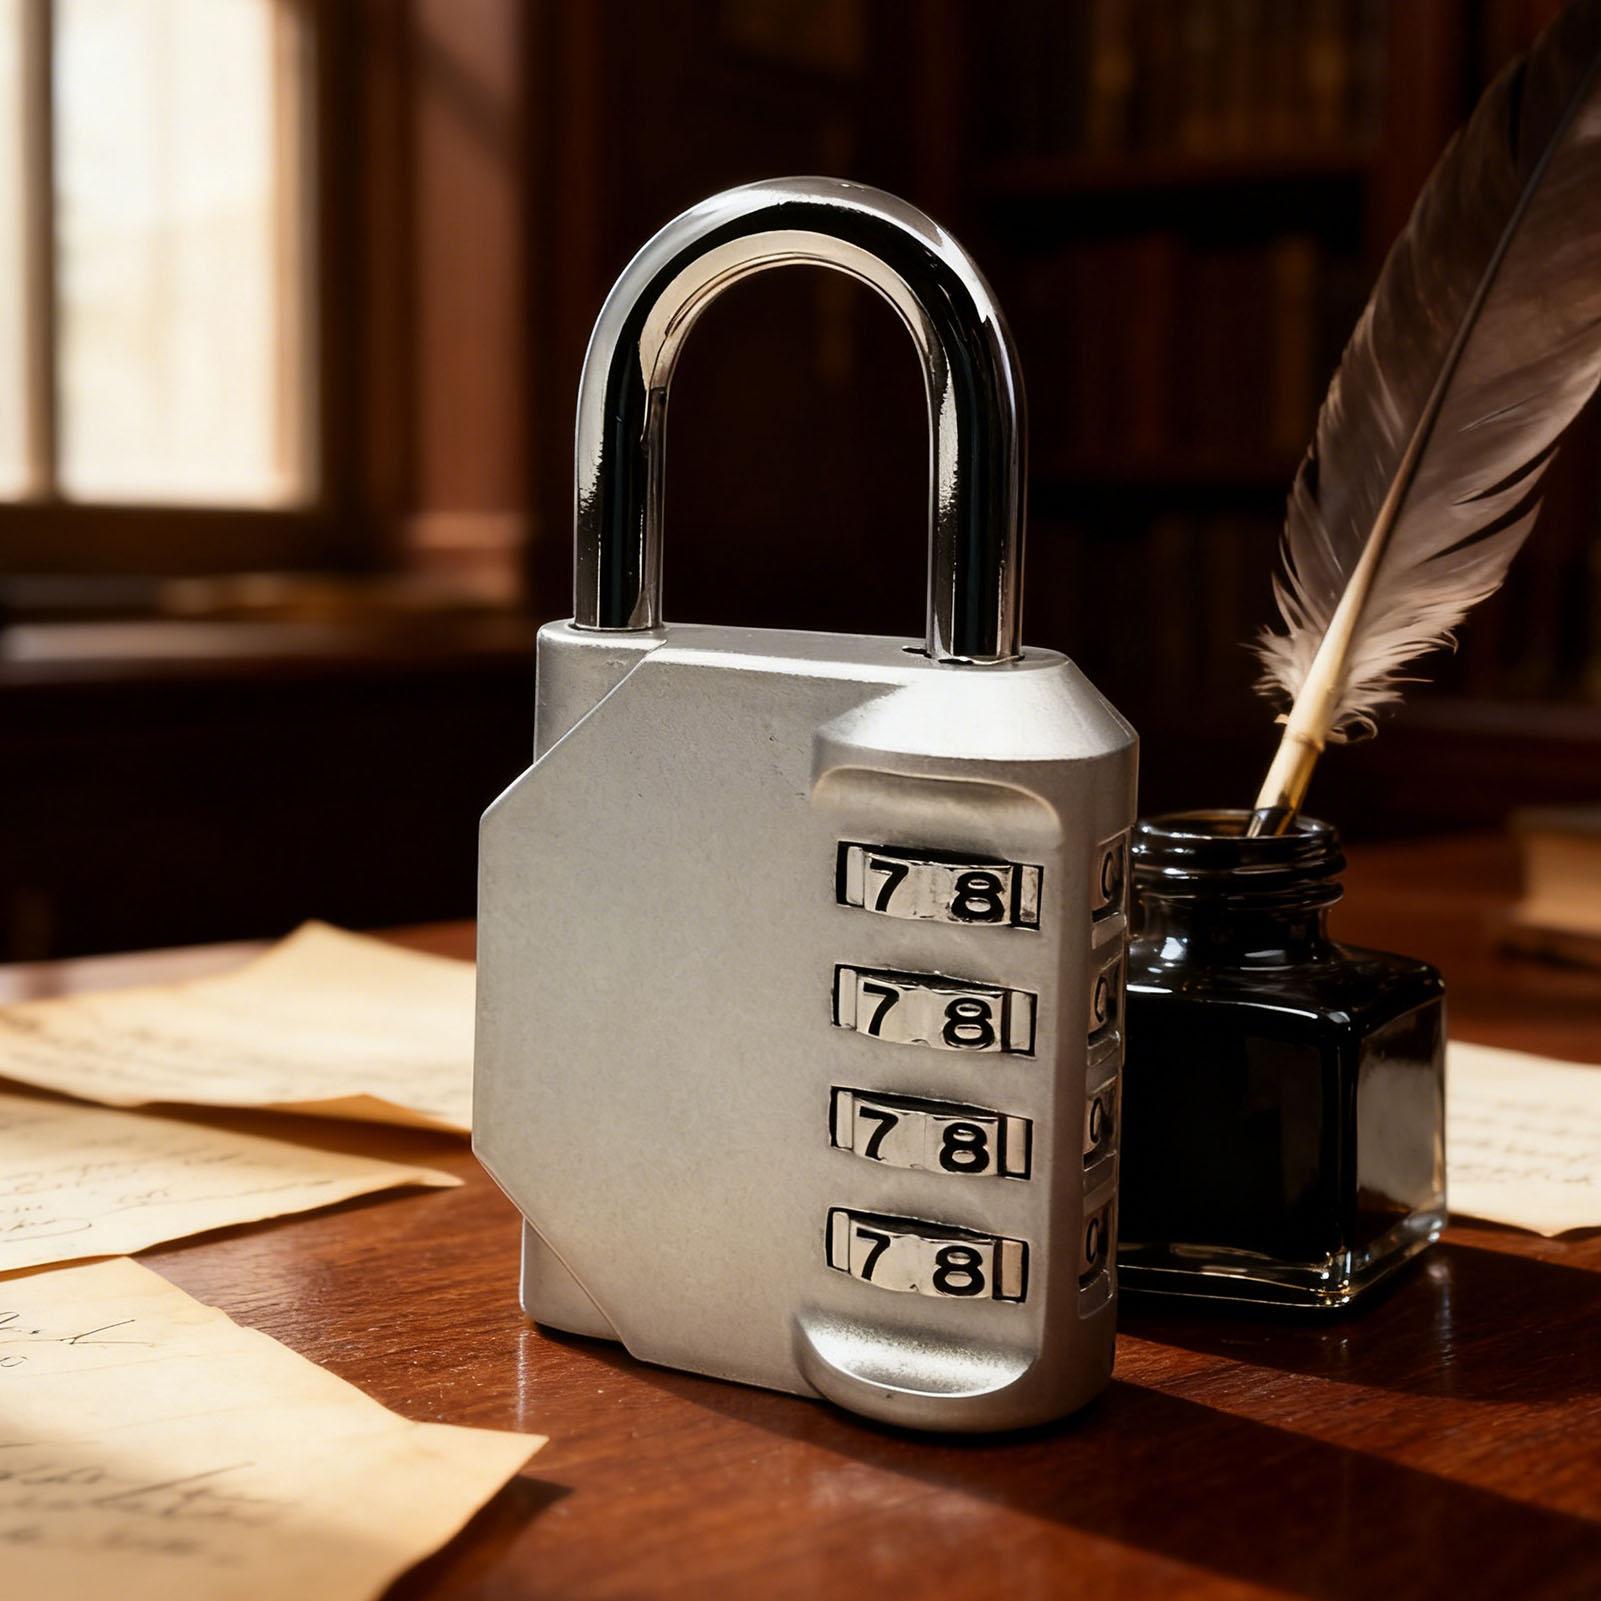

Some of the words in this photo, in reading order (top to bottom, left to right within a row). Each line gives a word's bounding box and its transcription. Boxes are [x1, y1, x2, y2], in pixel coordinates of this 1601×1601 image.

[870, 858, 909, 912] 7
[951, 871, 1005, 922] 8
[863, 981, 900, 1036] 7
[943, 997, 995, 1049] 8
[859, 1105, 899, 1161] 7
[939, 1122, 990, 1173] 8
[856, 1228, 891, 1281] 7
[932, 1245, 985, 1296] 8
